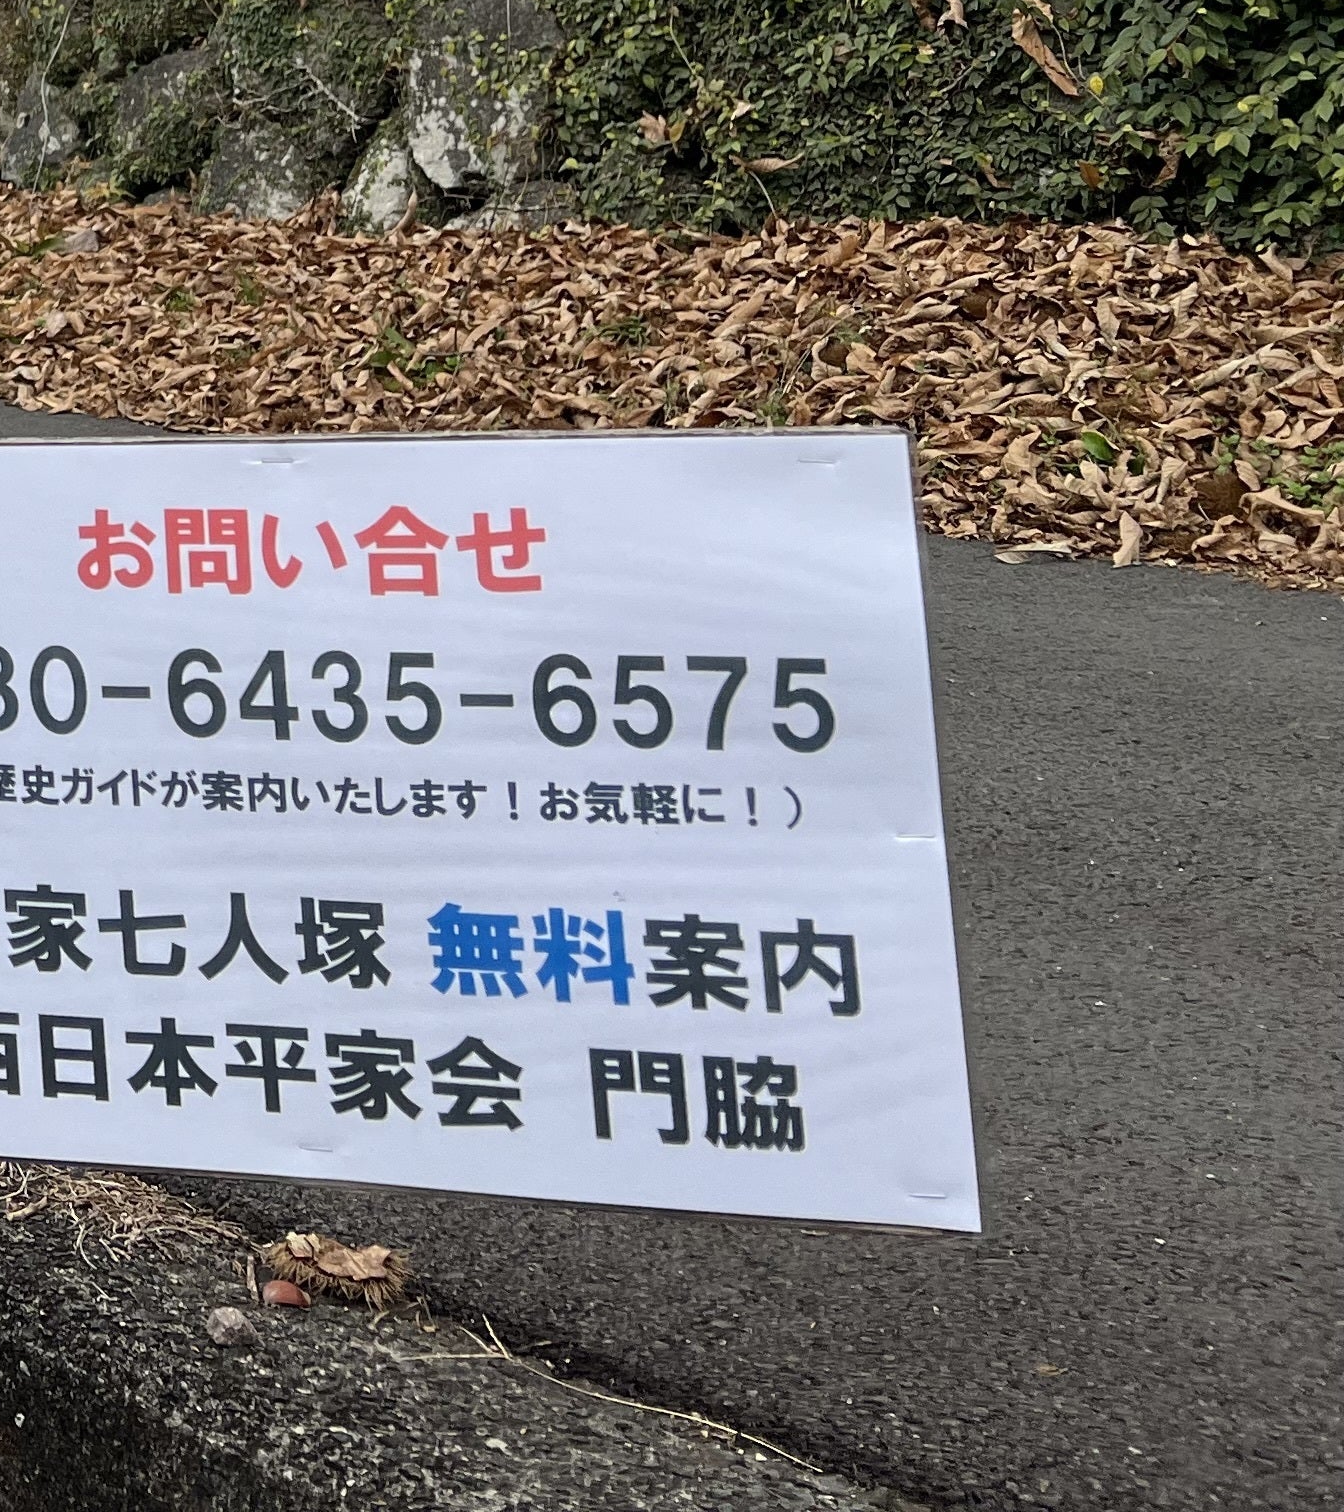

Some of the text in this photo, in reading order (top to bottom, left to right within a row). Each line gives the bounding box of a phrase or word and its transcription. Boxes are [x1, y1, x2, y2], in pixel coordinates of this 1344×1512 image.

[78, 506, 545, 595] お問い合せ
[427, 903, 860, 1016] 無料案内
[589, 1048, 805, 1151] 門脇
